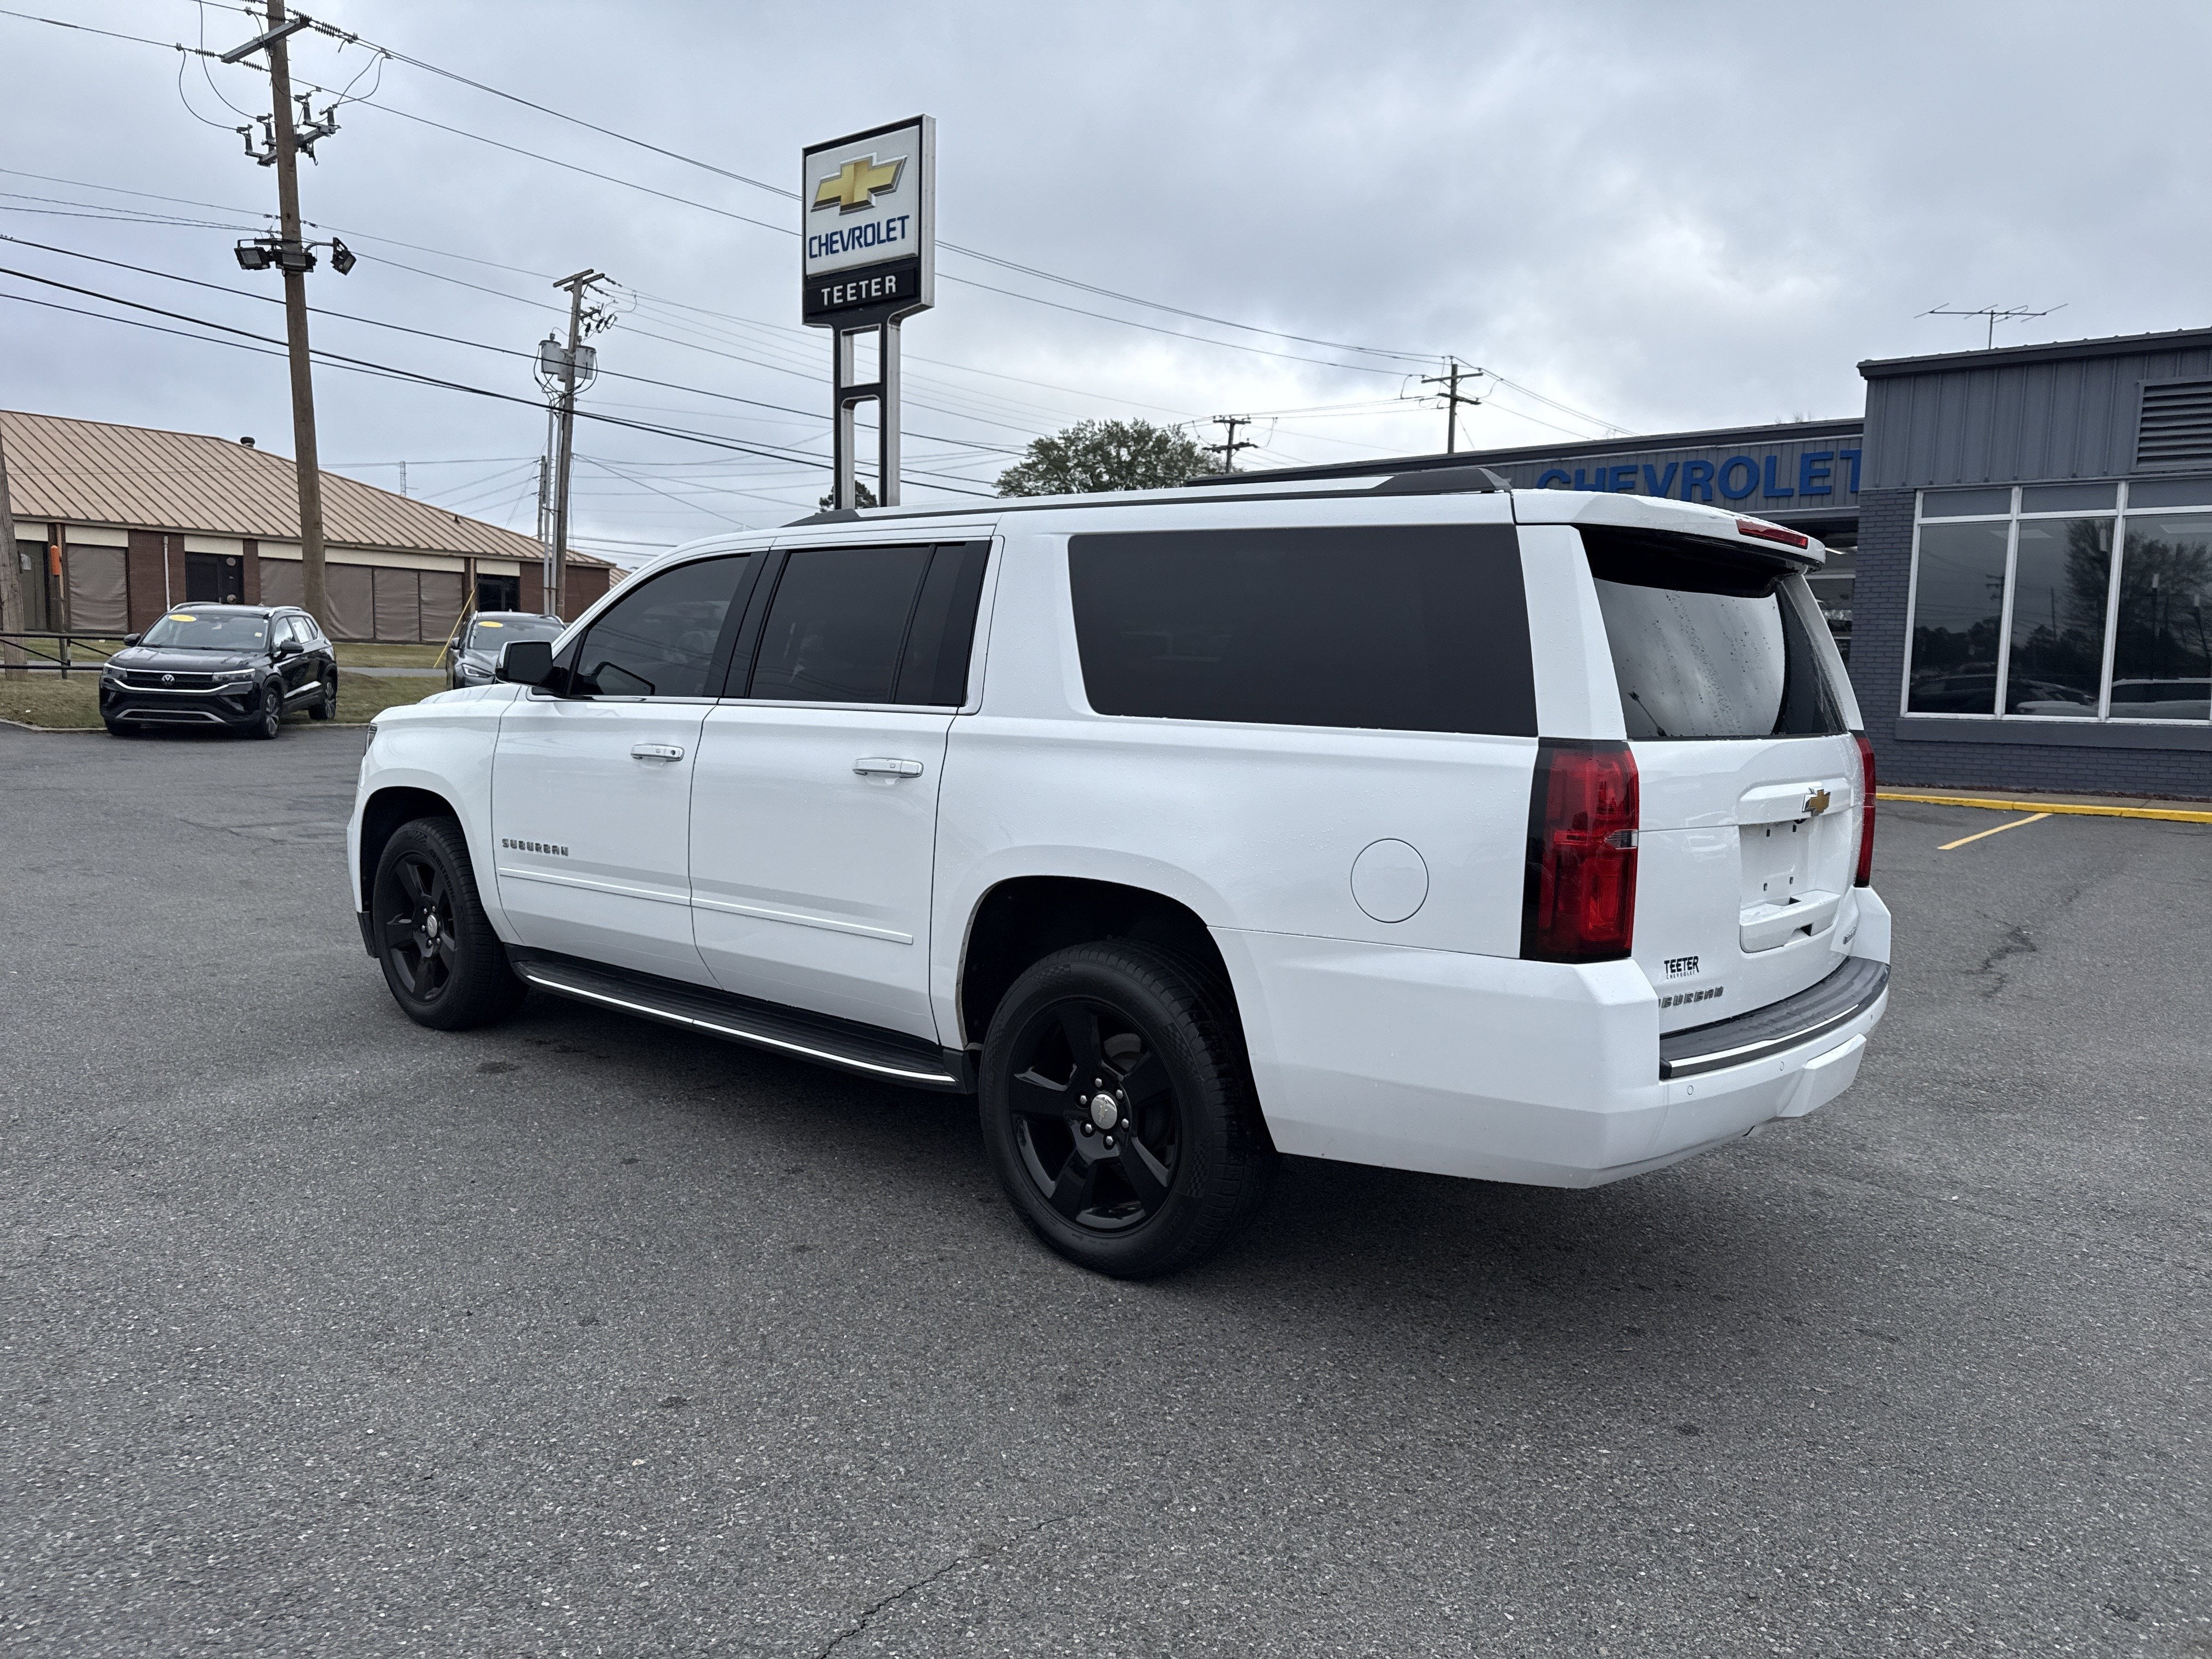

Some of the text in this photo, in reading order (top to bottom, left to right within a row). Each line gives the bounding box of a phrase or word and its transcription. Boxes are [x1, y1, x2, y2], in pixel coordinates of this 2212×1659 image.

[809, 215, 910, 259] CHEVROLET
[821, 275, 896, 306] TEETER
[502, 838, 569, 856] SUBURBAN
[427, 849, 456, 902] ARMSTRONG
[1663, 956, 1700, 974] TEETER
[1666, 970, 1695, 980] CHEVROLET
[1658, 986, 1724, 1008] BURBAN
